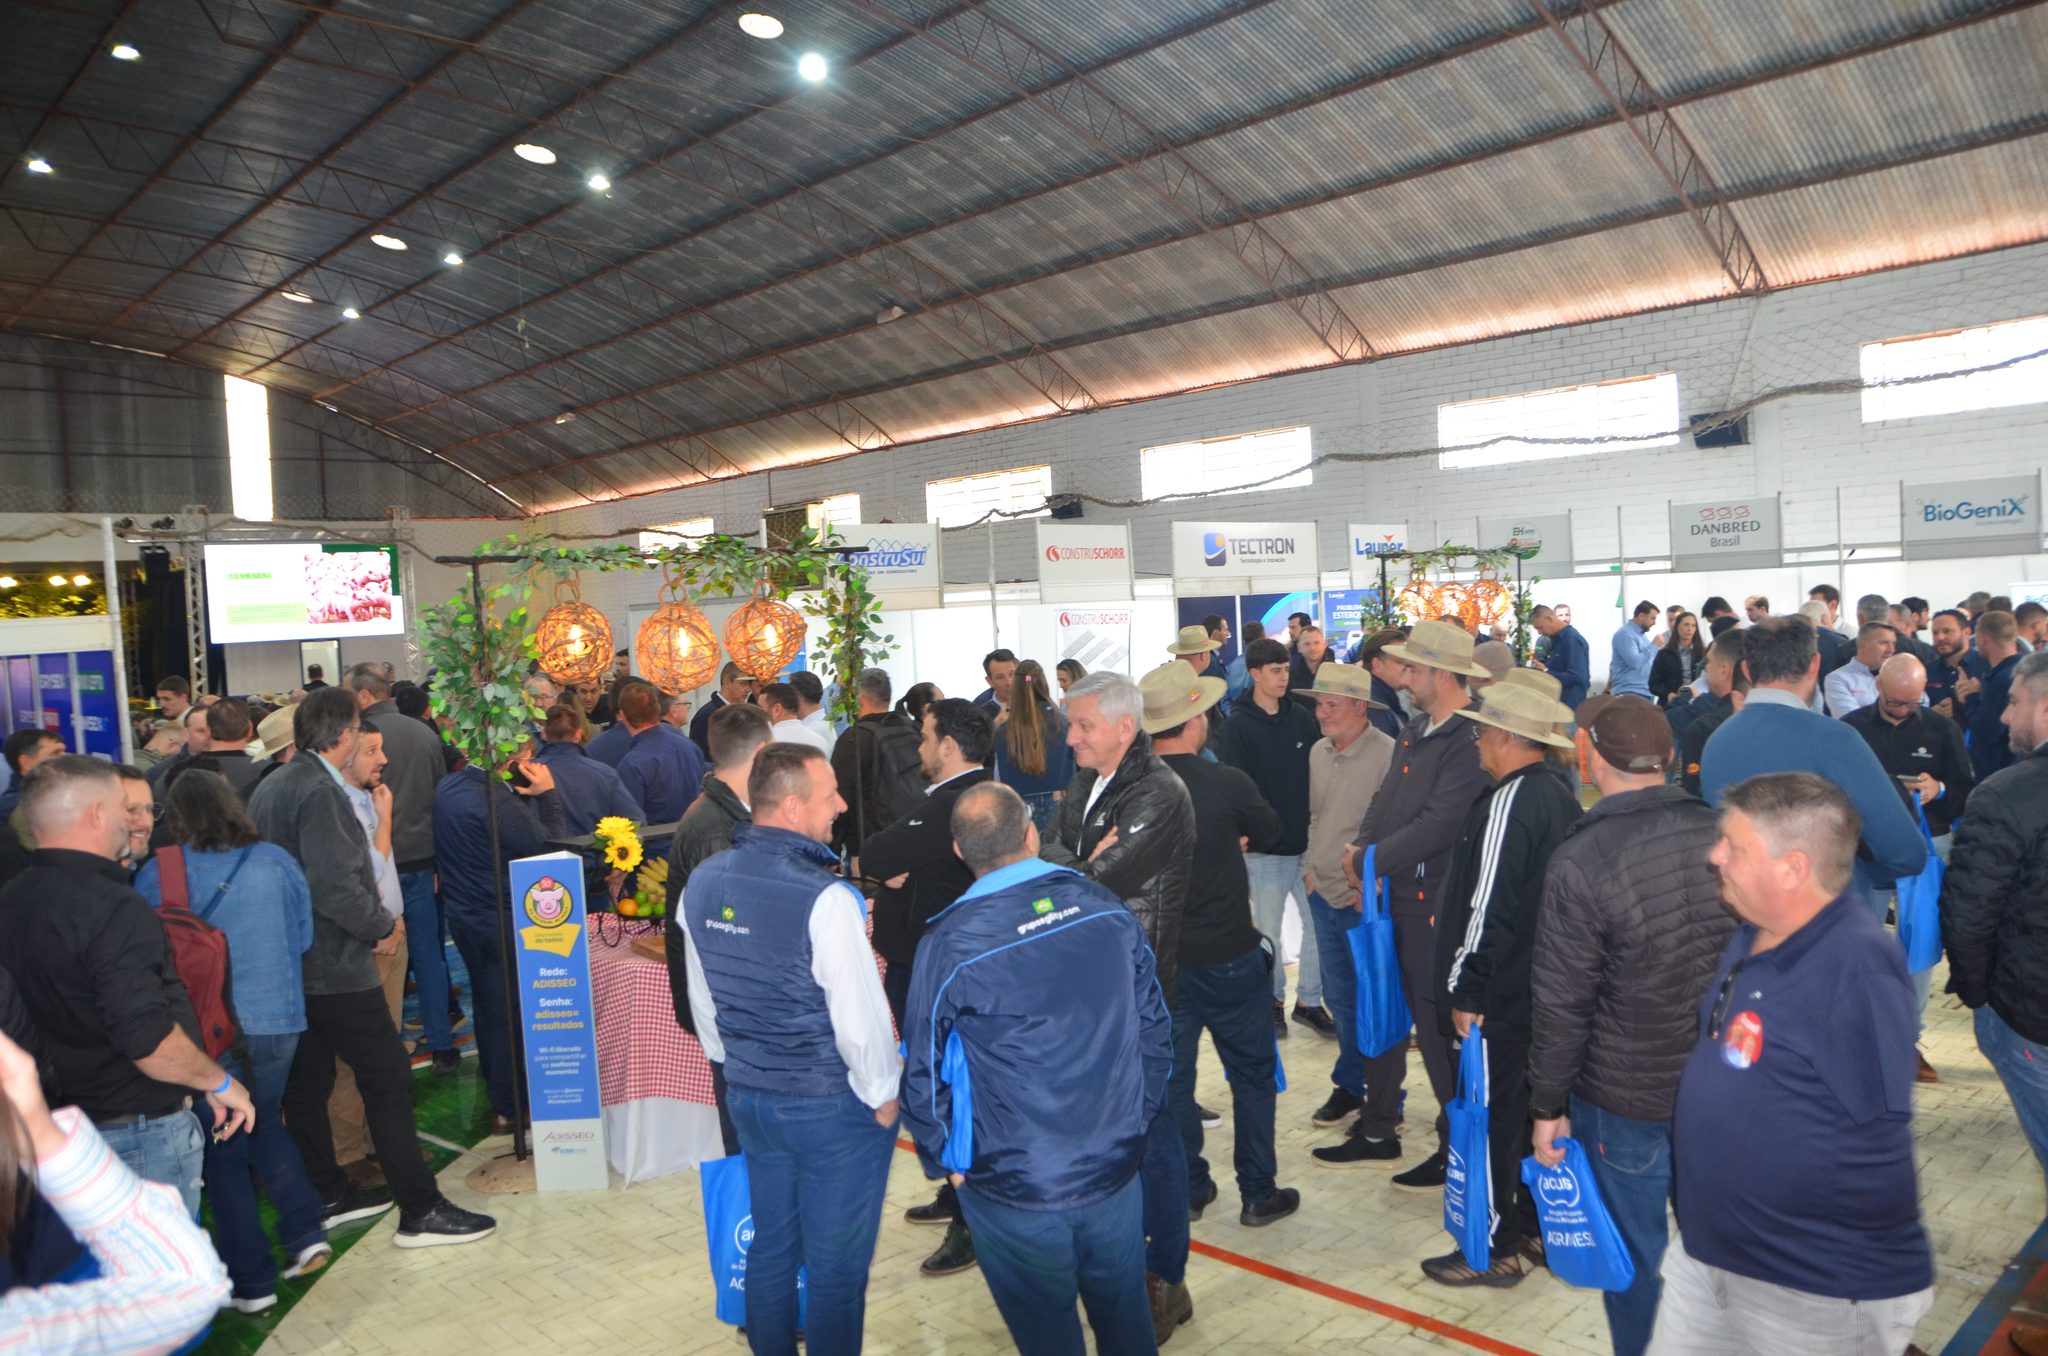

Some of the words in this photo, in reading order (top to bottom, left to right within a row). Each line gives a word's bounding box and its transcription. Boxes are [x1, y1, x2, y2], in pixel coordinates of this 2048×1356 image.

[1924, 498, 2025, 522] BioGeniX
[1690, 520, 1761, 536] DANBRED
[1228, 538, 1295, 555] TECTRON
[1710, 535, 1740, 548] Brasil
[837, 546, 927, 567] onstruSui
[1060, 547, 1125, 560] CONSTRUSCHORR
[1071, 613, 1128, 625] CONSTRUSCHORR
[539, 967, 568, 977] Rede:
[532, 978, 577, 989] ADISSEO
[539, 997, 573, 1007] Senha:
[532, 1021, 584, 1031] resultados
[542, 1131, 595, 1143] ADISSEO
